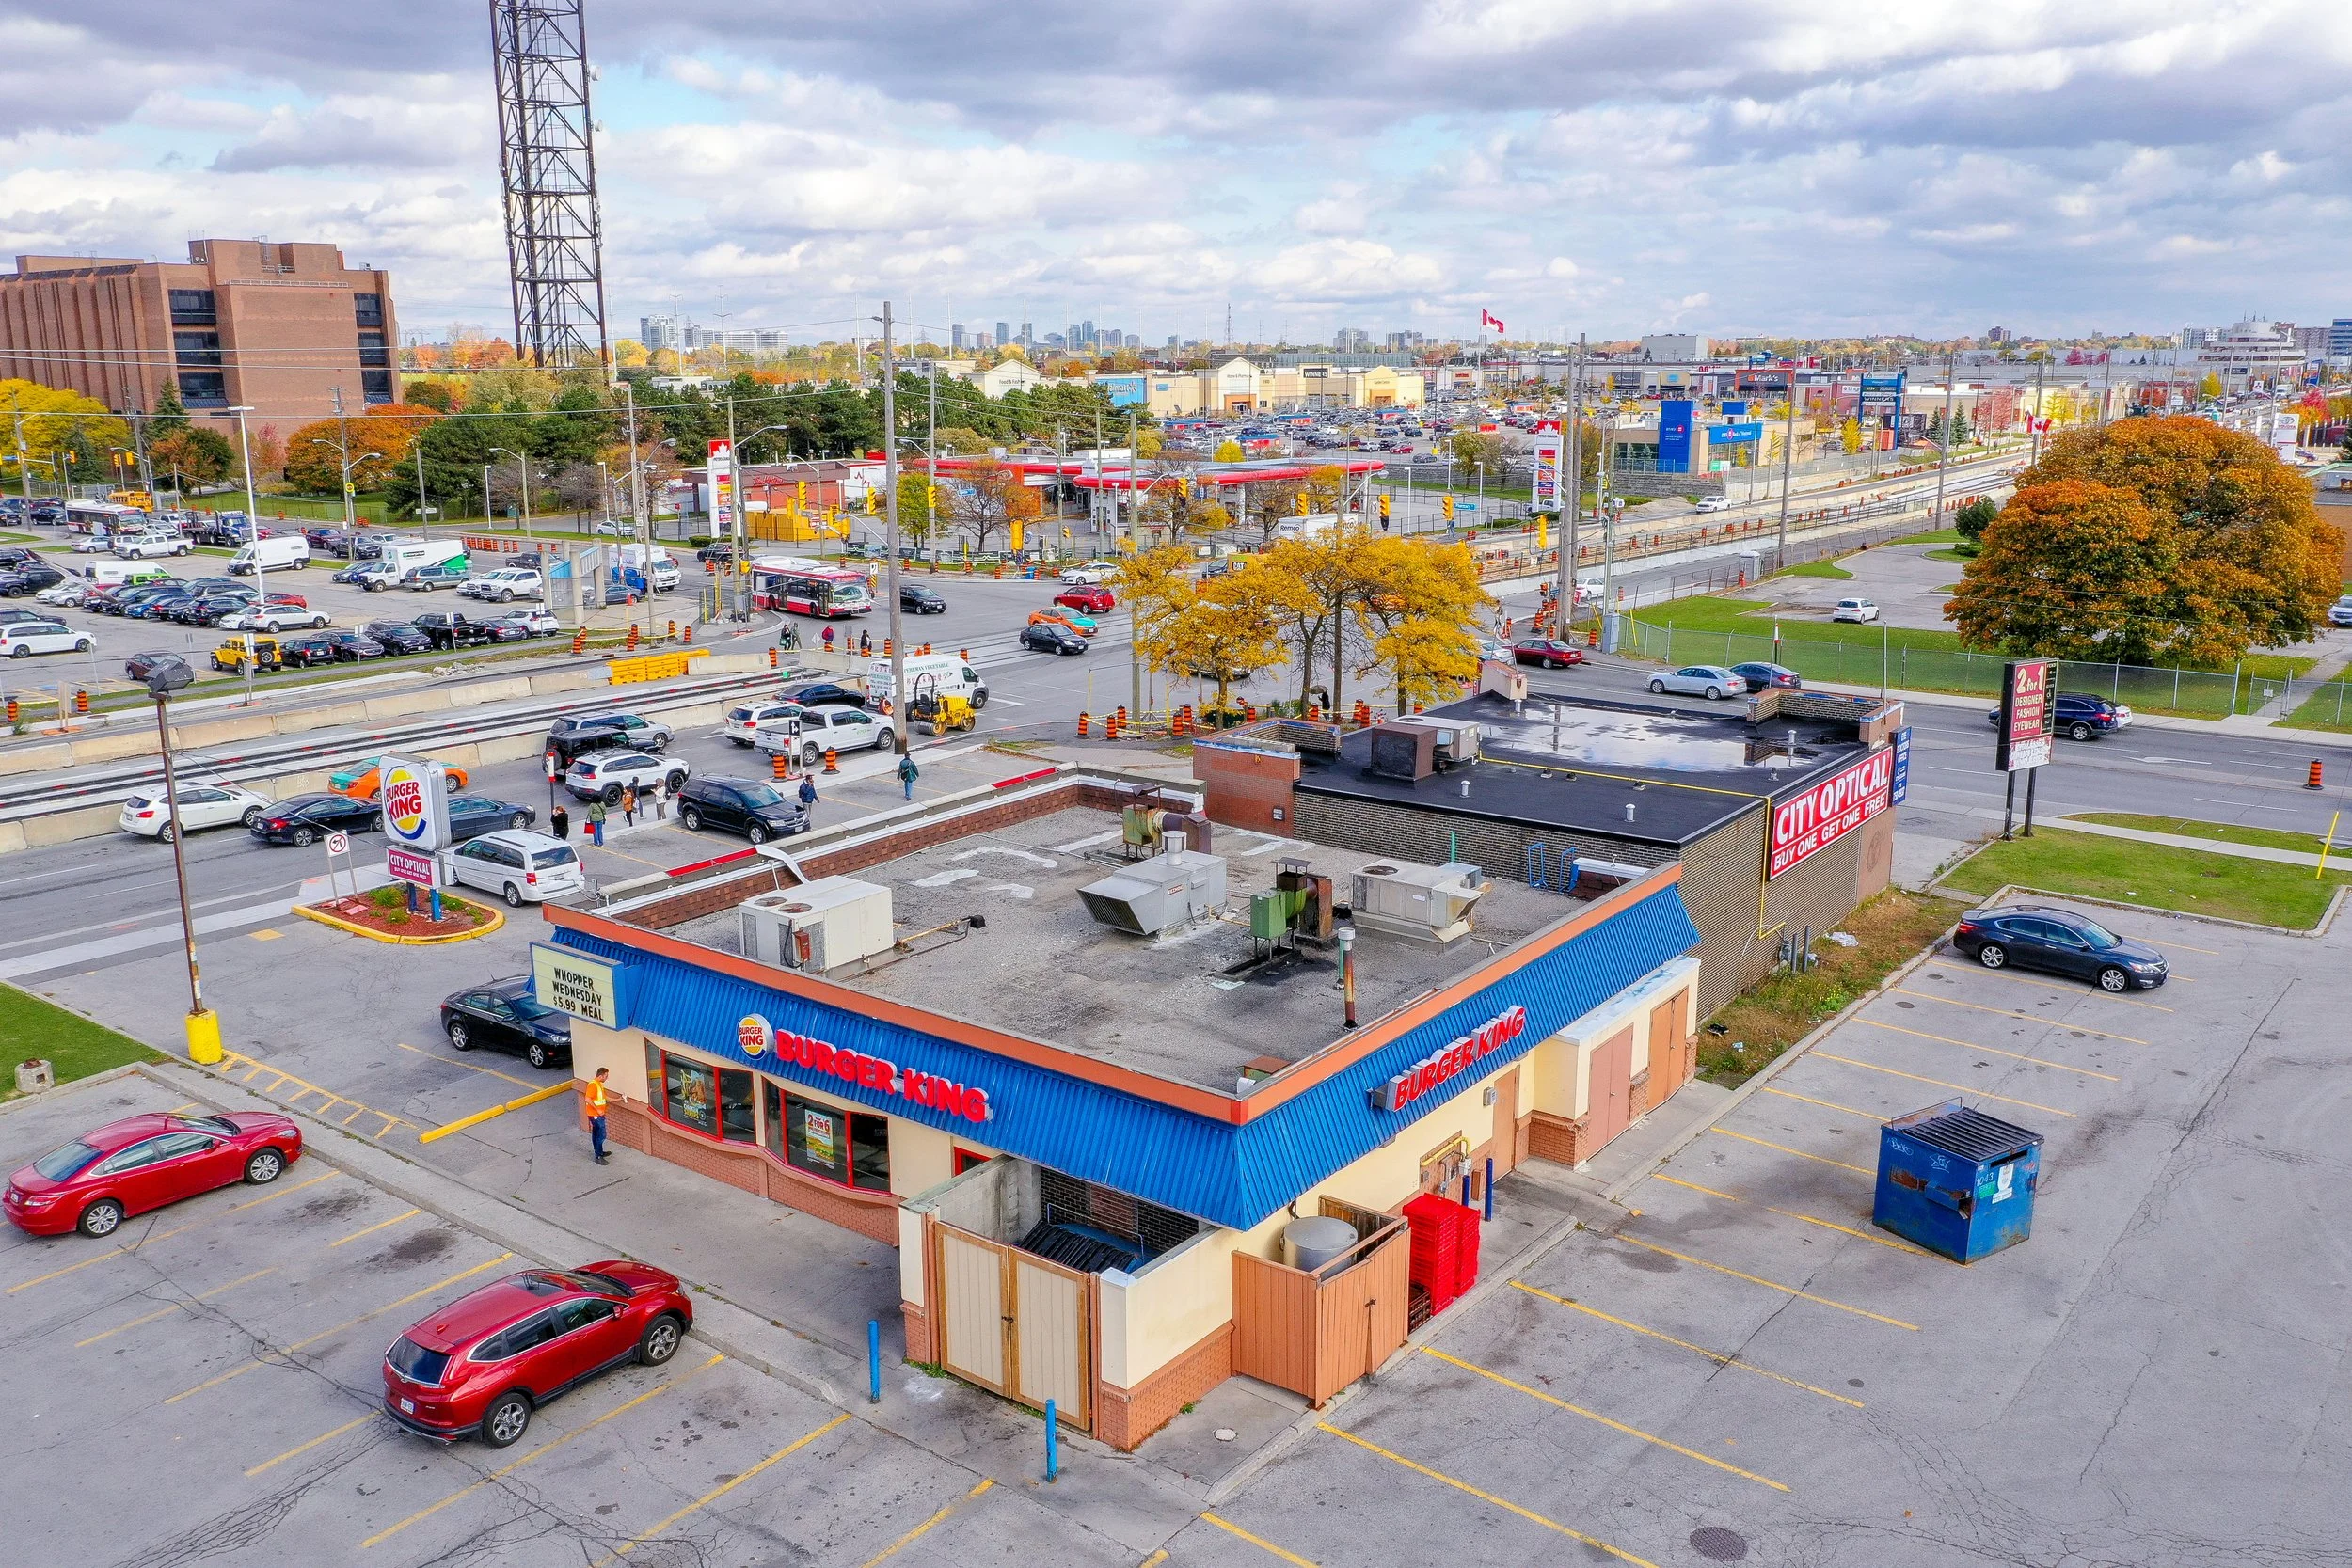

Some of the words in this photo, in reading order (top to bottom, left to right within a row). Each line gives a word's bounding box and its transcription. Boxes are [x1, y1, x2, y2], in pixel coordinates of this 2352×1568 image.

[1108, 382, 1129, 392] almart
[1233, 562, 1245, 570] CAT
[2017, 668, 2027, 694] 2
[2027, 677, 2037, 692] for
[2038, 665, 2044, 691] 1
[2015, 694, 2042, 707] DESIGNER
[2016, 707, 2039, 719] FASHION
[2014, 719, 2039, 732] EYEWEAR
[386, 781, 419, 803] BURGER
[1777, 790, 1818, 845] CITY
[1820, 755, 1888, 819] OPTICAL
[387, 795, 422, 821] KING
[1774, 849, 1795, 871] BUY
[1797, 835, 1817, 857] ONE
[1822, 819, 1840, 841] GET
[1842, 807, 1860, 829] ONE
[1864, 793, 1886, 817] FREE
[390, 854, 403, 867] CITY
[404, 858, 430, 875] OPTICAL
[554, 967, 594, 990] WHOPPER
[552, 981, 602, 1006] WEDNESDAY
[553, 996, 575, 1012] $5.99
[581, 1003, 604, 1021] MEAL
[739, 1026, 763, 1036] BURGER
[740, 1033, 764, 1046] KING
[1394, 1038, 1475, 1112] BURGER
[1476, 1006, 1526, 1060] KING
[776, 1029, 897, 1095] BURGER
[903, 1068, 989, 1122] KING
[808, 1114, 813, 1127] 2
[814, 1120, 824, 1130] FOR
[1976, 1172, 1994, 1187] 1043
